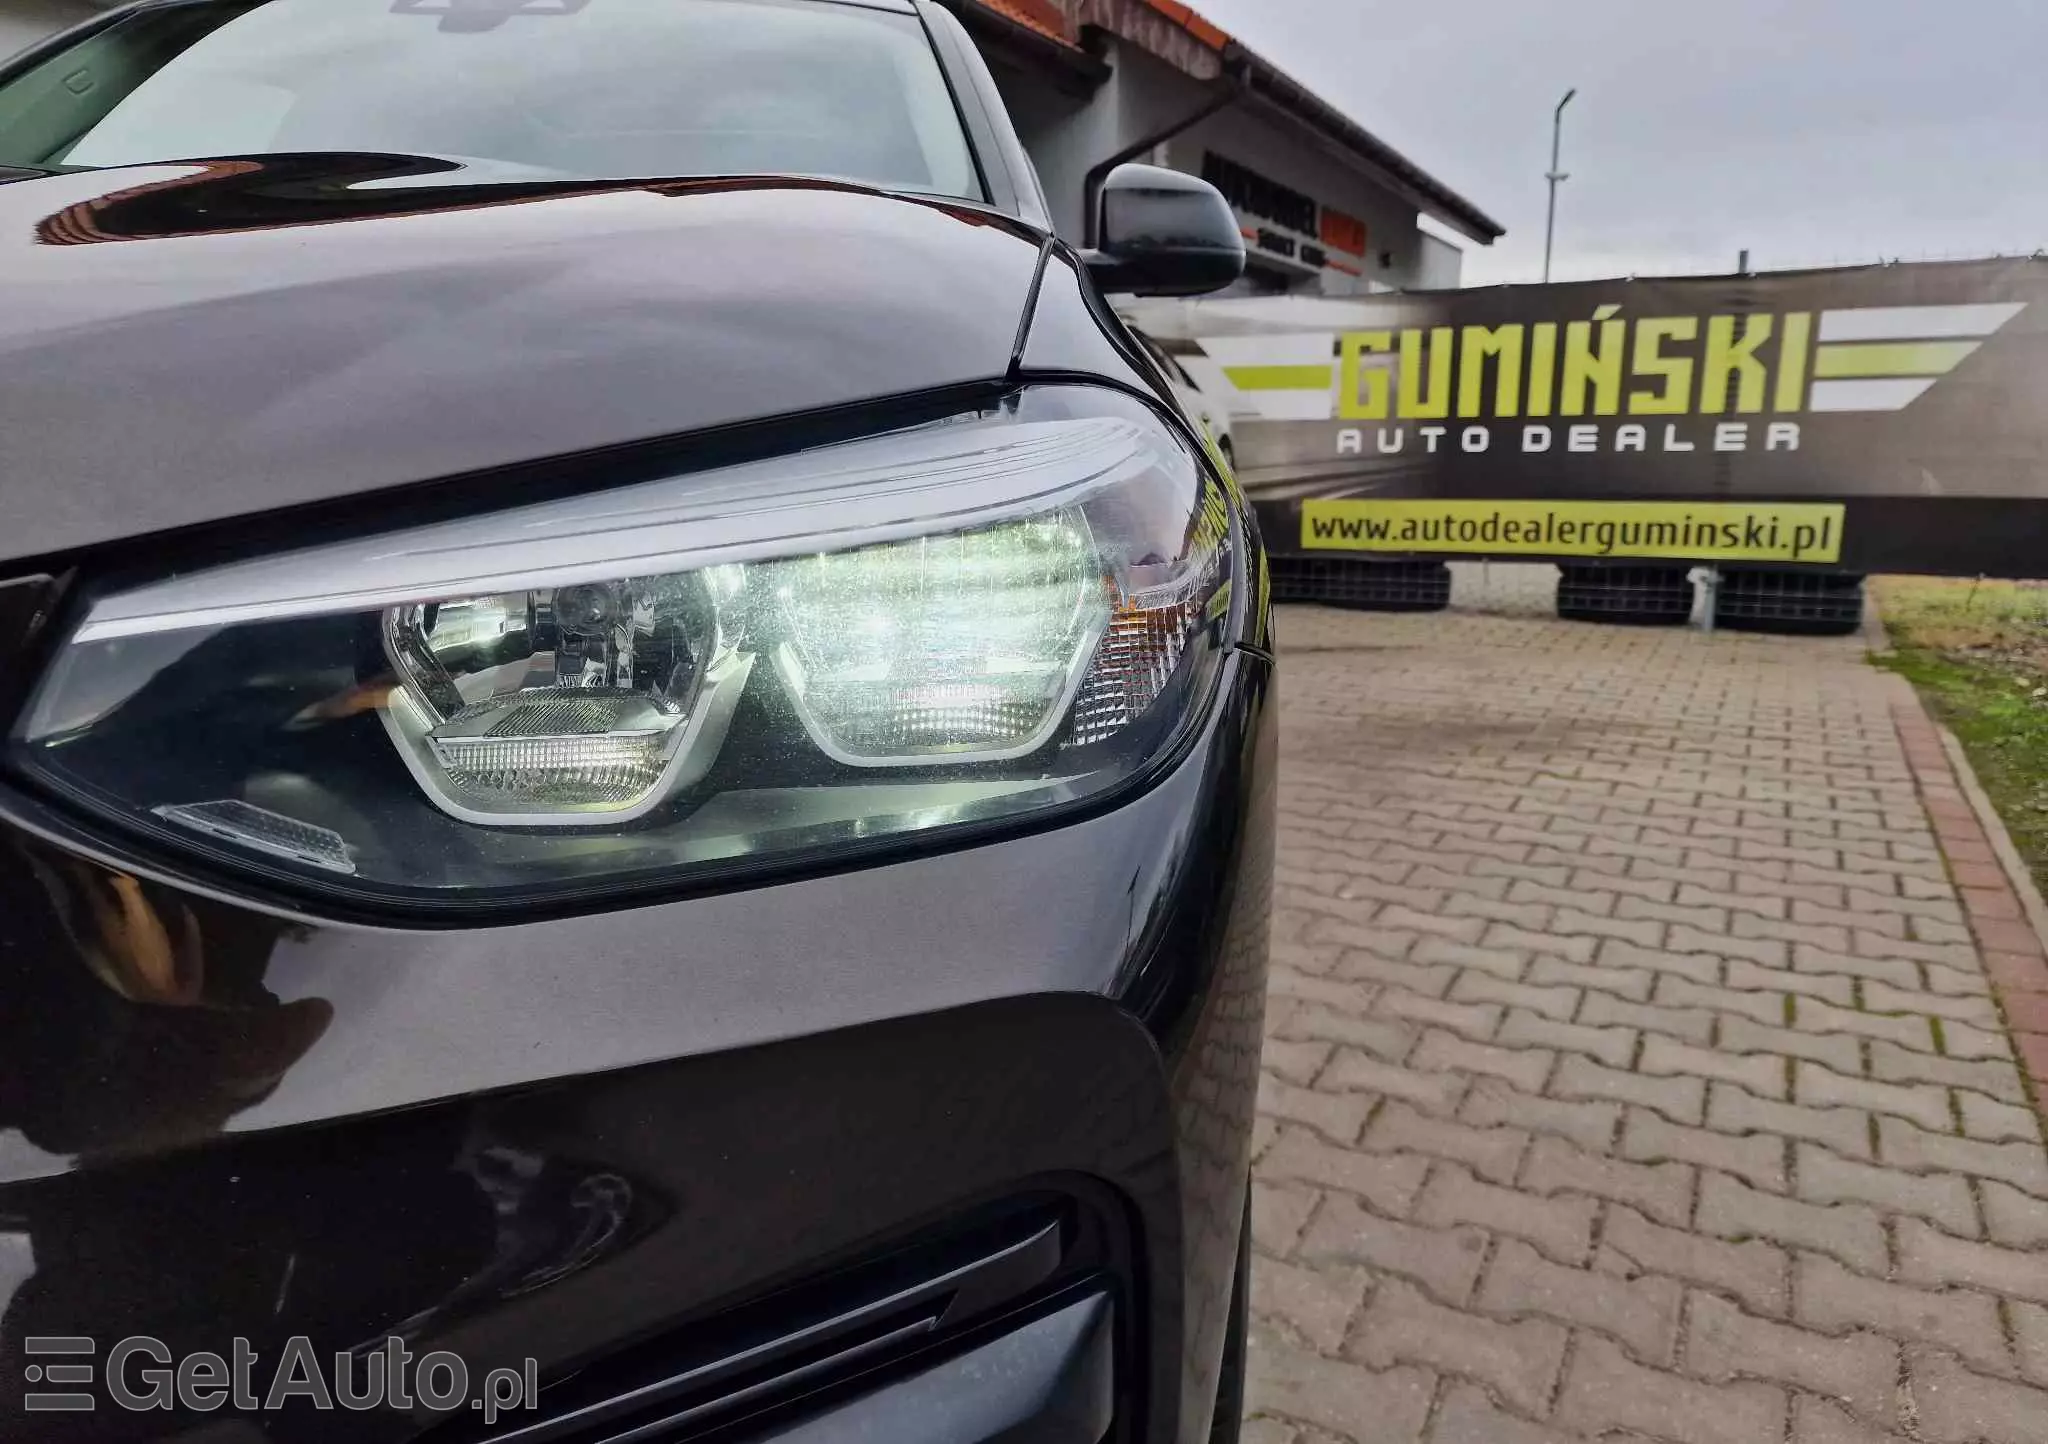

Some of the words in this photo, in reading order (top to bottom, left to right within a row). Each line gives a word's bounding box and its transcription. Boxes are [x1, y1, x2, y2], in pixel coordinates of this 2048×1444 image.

[1338, 303, 1812, 420] GUMIŃSKI
[1335, 425, 1492, 454] AUTO
[1521, 422, 1802, 454] DEALER
[1312, 508, 1832, 555] www.autodealerguminski.pl
